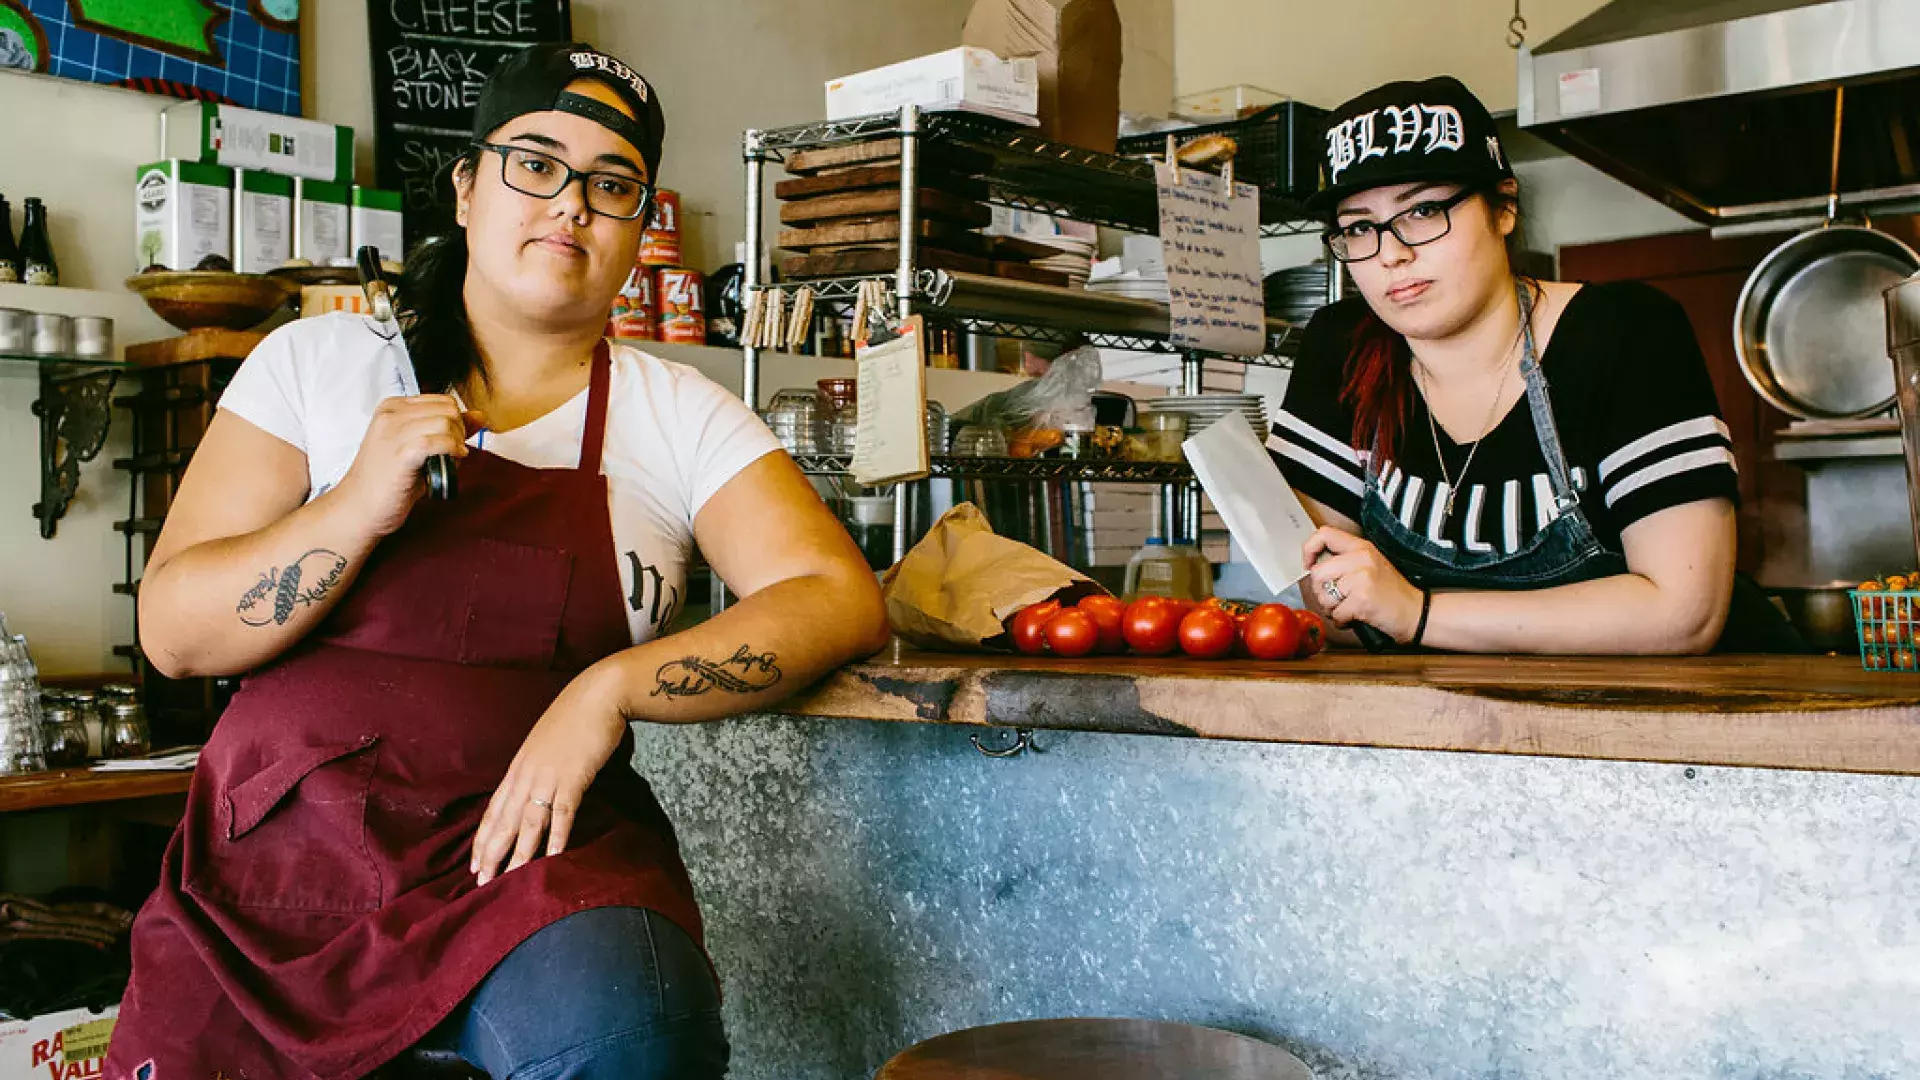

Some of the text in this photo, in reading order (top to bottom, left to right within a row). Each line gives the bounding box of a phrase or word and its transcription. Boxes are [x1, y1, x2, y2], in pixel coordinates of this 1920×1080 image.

[390, 0, 537, 35] CHEESE
[387, 47, 488, 81] BLACK
[1325, 103, 1465, 185] BLVD
